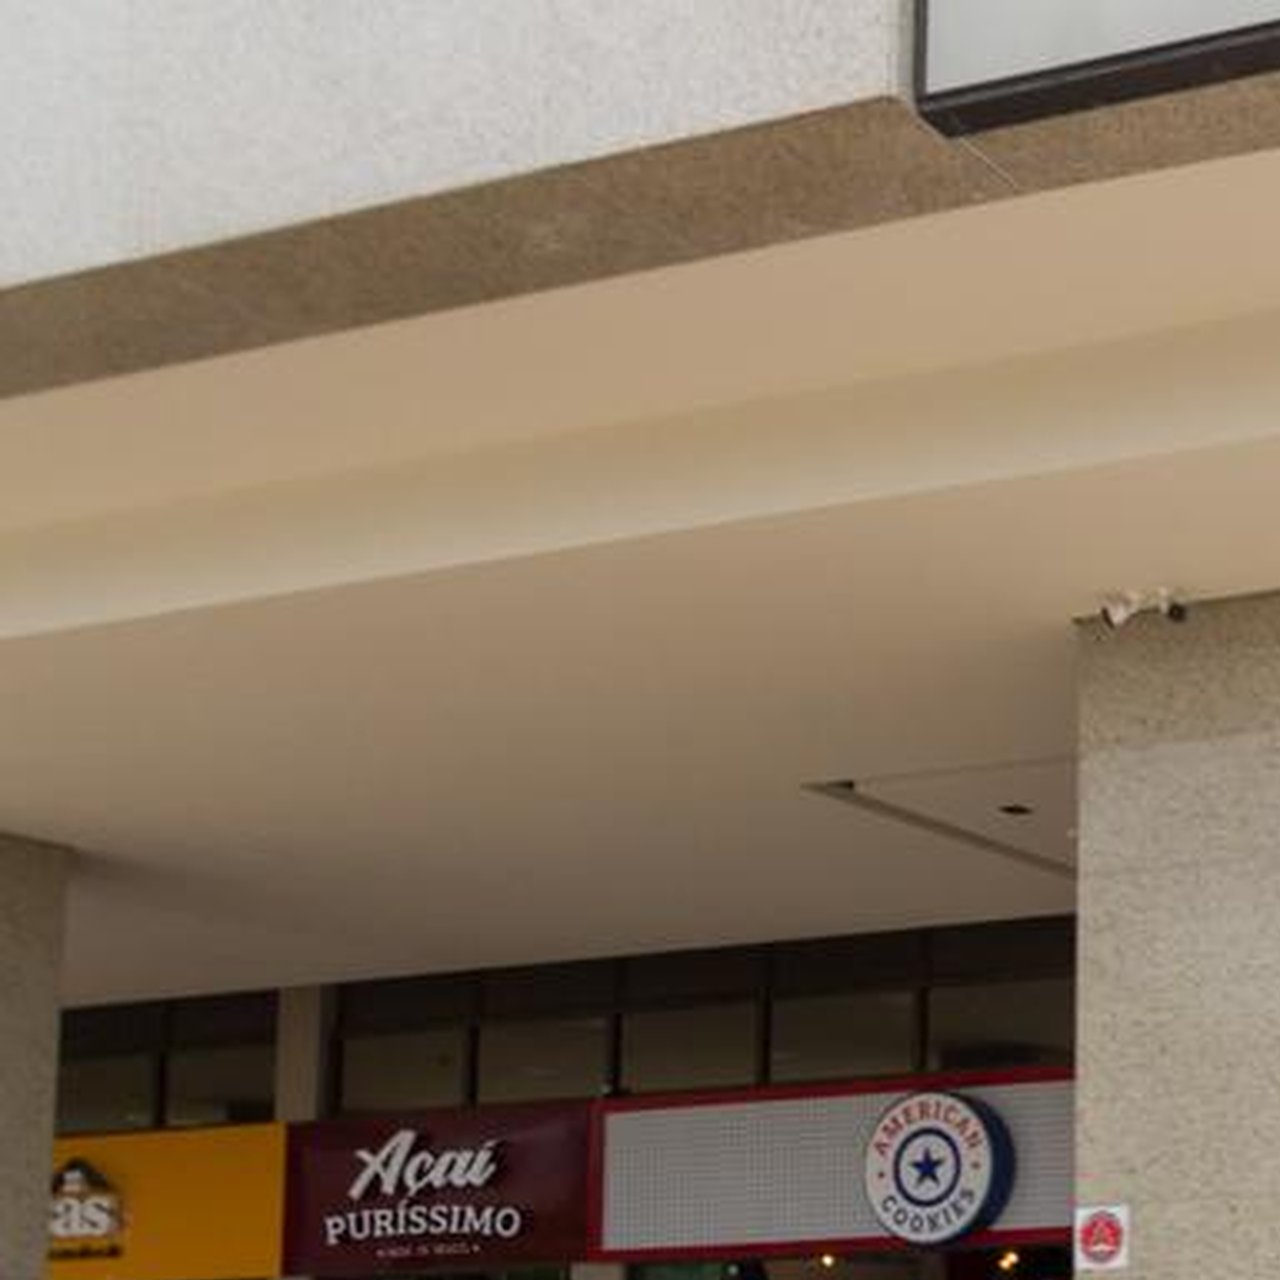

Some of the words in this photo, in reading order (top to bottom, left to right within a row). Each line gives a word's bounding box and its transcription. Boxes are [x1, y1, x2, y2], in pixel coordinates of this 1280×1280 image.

[873, 1100, 983, 1158] AMERICAN
[348, 1130, 500, 1200] Açaí
[325, 1199, 521, 1245] PURÍSSIMO
[881, 1188, 975, 1233] COOKIES
